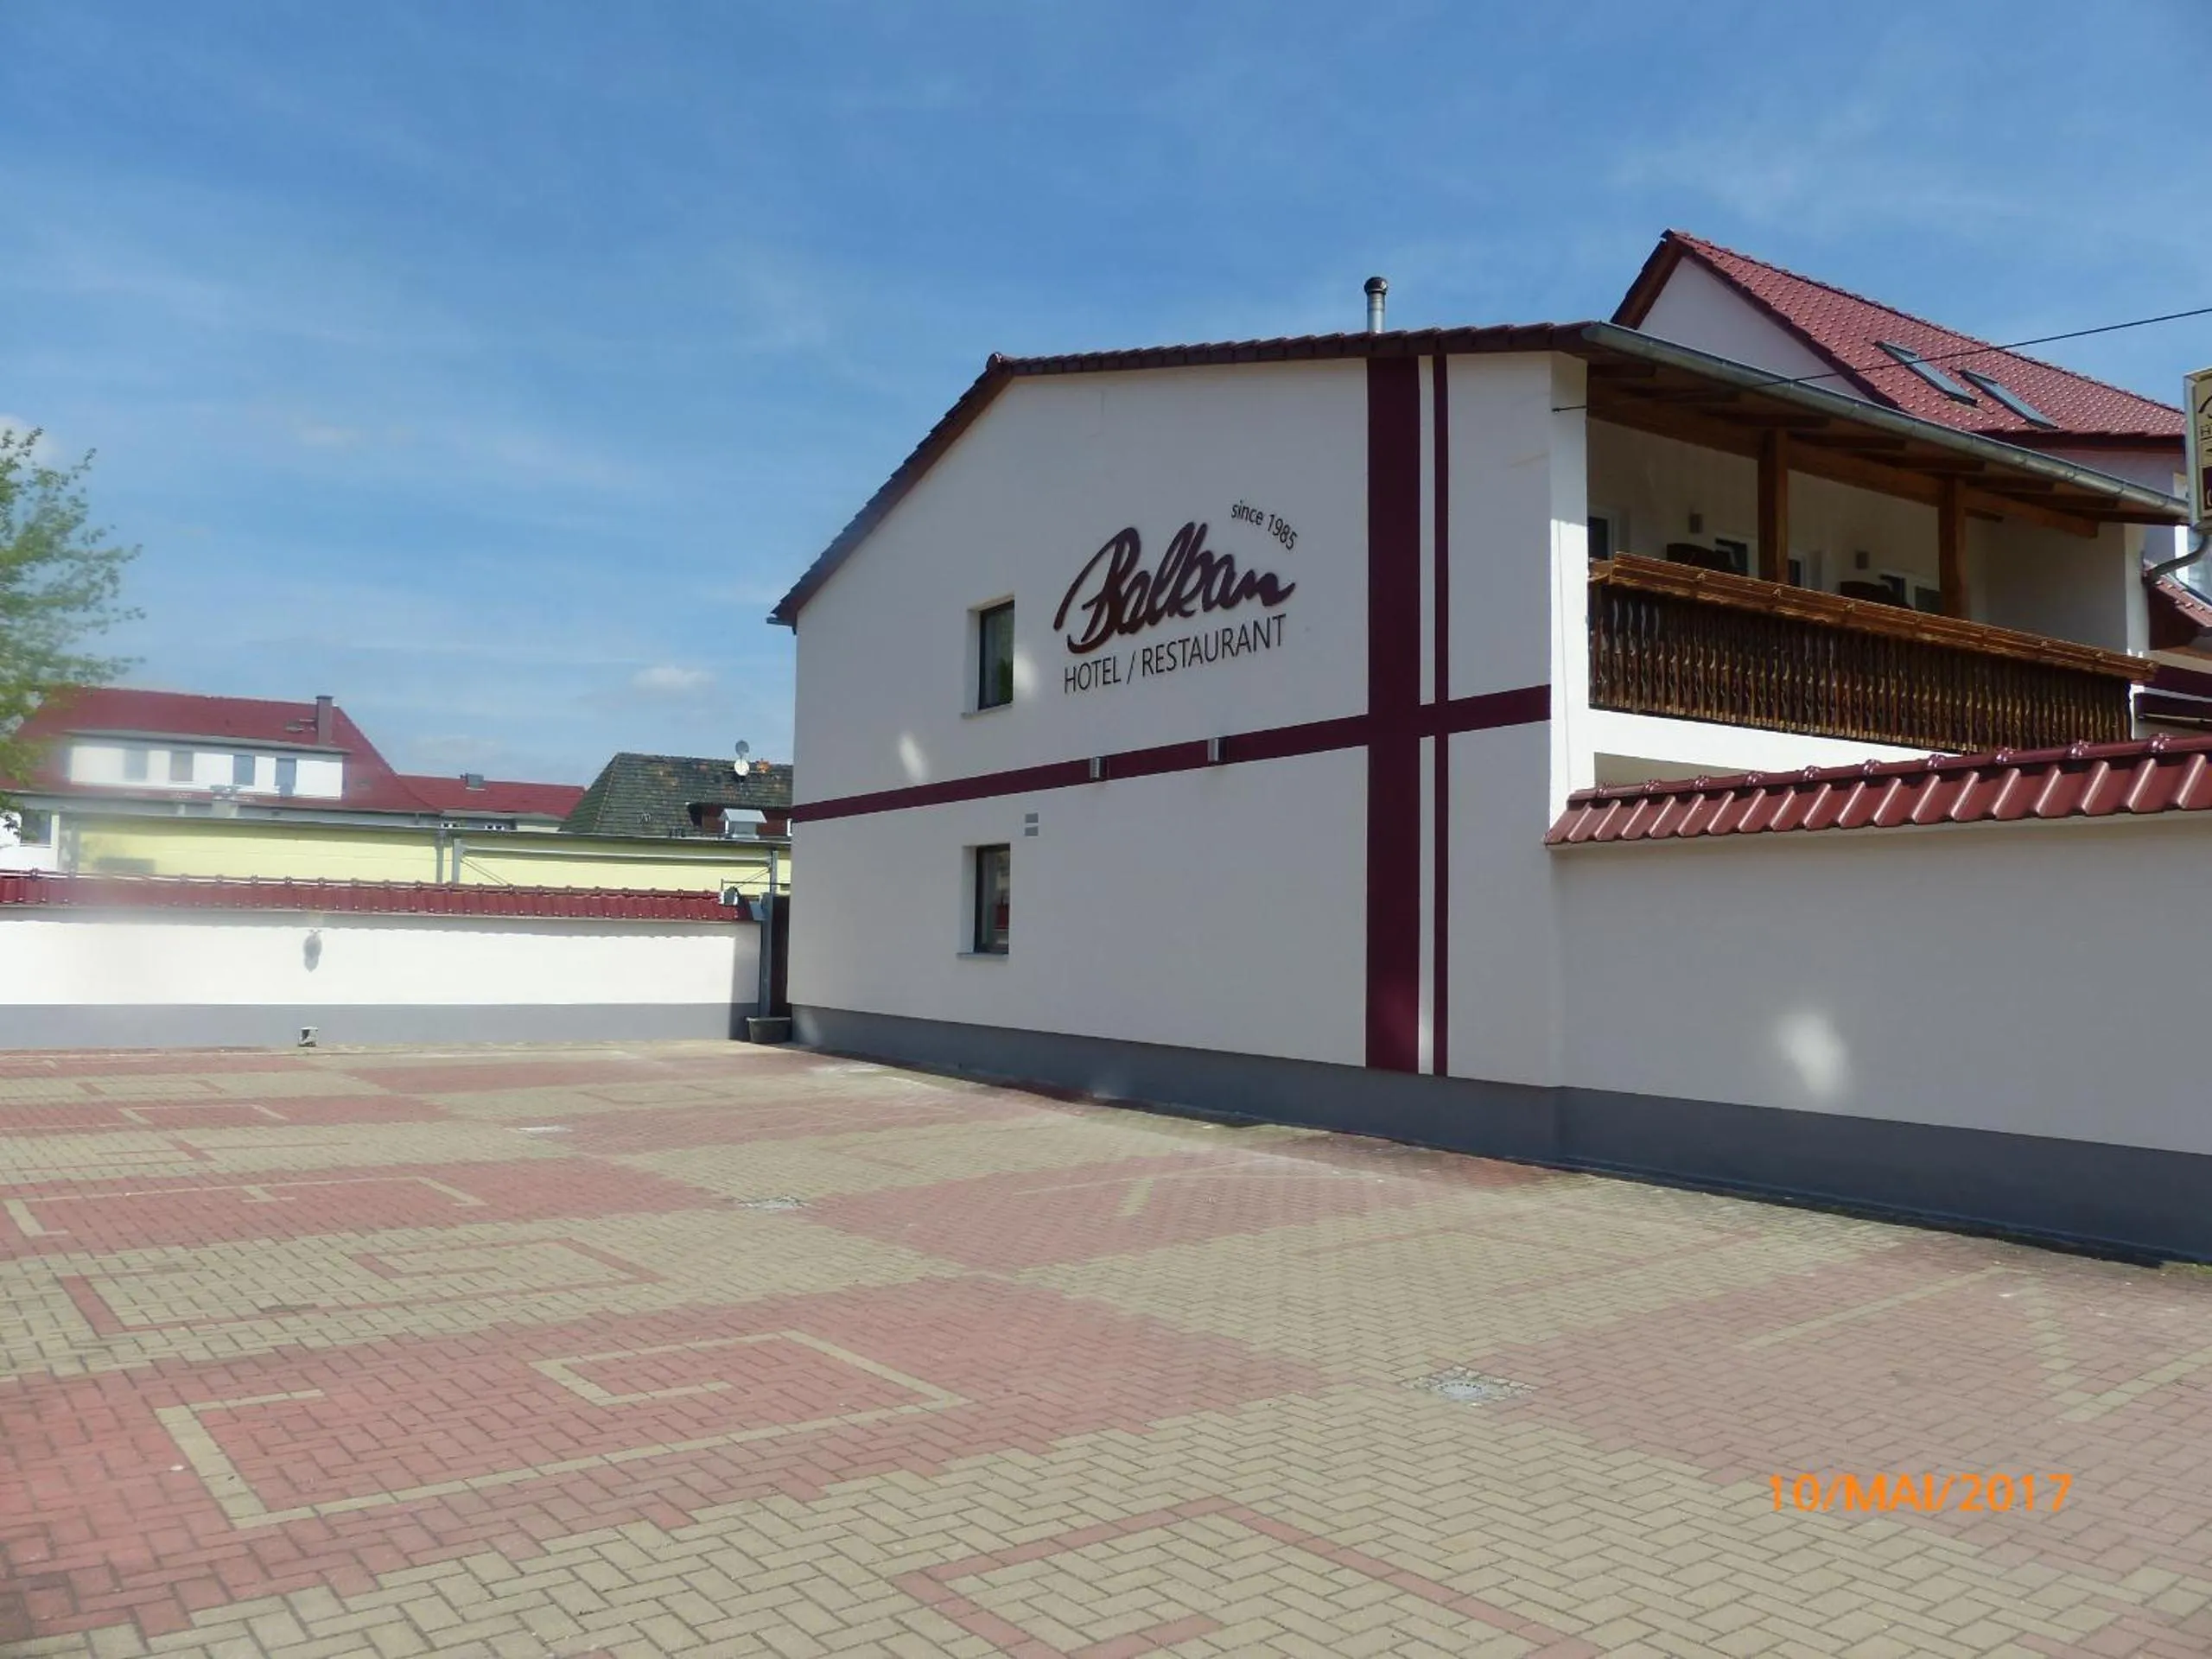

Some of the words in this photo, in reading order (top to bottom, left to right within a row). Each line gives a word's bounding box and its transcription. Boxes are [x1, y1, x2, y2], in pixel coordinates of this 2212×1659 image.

[1230, 499, 1263, 525] since
[1267, 514, 1298, 550] 1985
[1053, 522, 1296, 654] Balkan
[1065, 656, 1121, 693] HOTEL
[1141, 613, 1287, 676] RESTAURANT
